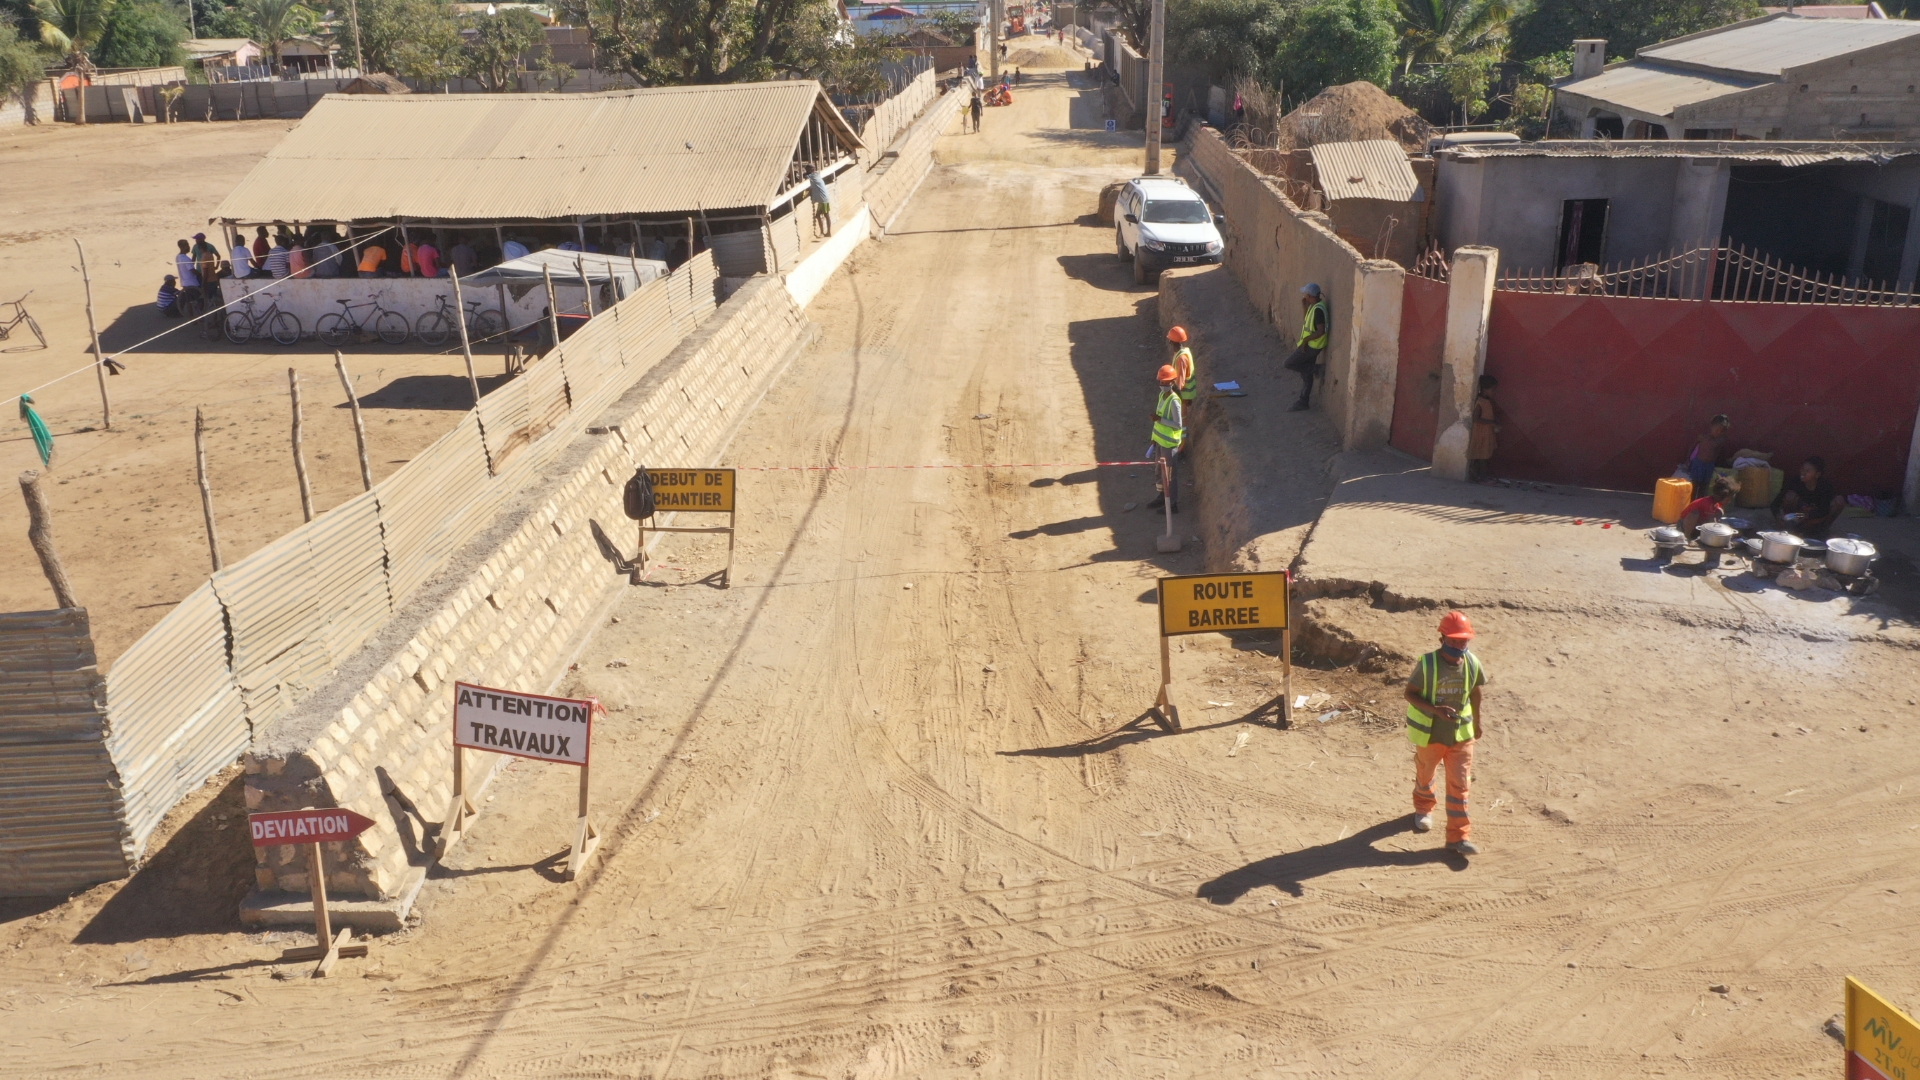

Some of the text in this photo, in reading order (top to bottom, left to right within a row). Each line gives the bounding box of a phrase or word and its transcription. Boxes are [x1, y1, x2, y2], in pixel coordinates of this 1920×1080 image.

[650, 472, 723, 486] DEBUT DE
[653, 492, 722, 506] CHANTIER
[1193, 580, 1254, 601] ROUTE
[1188, 606, 1260, 628] BARREE
[457, 689, 587, 724] ATTENTION
[470, 721, 571, 757] TRAVAUX
[251, 815, 349, 840] DEVIATION
